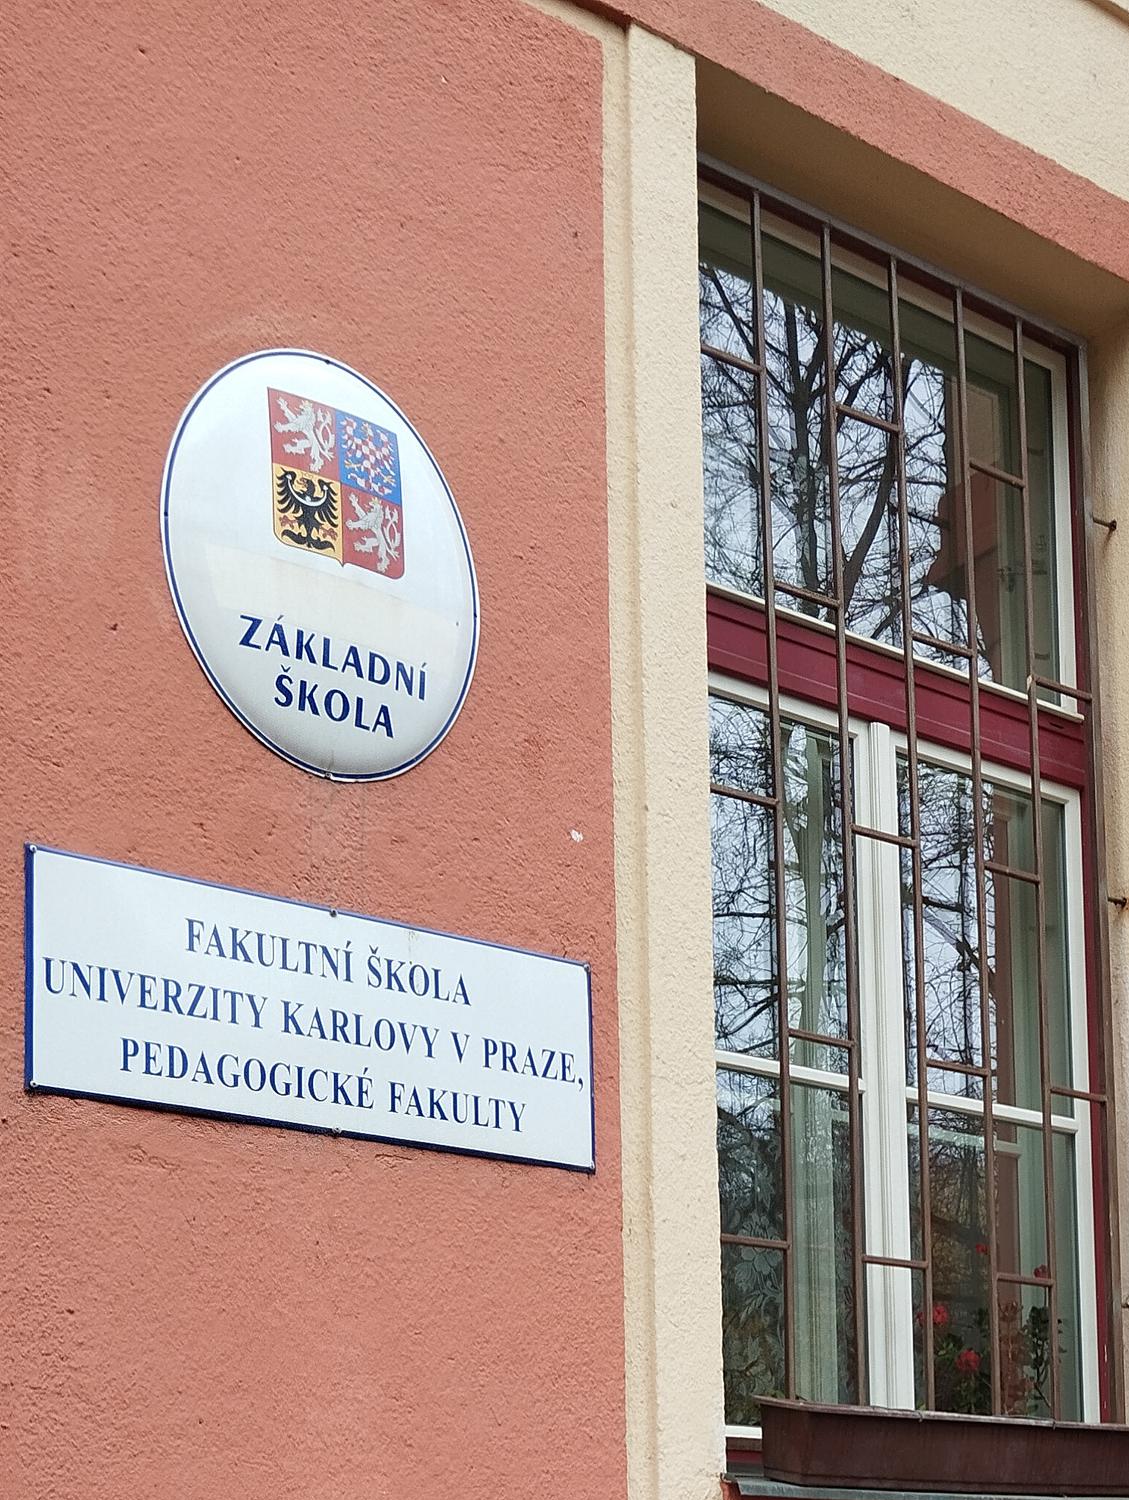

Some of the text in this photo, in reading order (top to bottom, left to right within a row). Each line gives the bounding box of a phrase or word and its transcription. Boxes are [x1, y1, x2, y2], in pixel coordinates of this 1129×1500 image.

[238, 614, 428, 701] ZÁKLADNÍ
[274, 664, 394, 739] ŠKOLA
[185, 917, 472, 1006] FAKULTNÍ ŠKOLA
[43, 956, 585, 1092] UNIVERZITY KARLOVY V PRAZE,
[119, 1037, 527, 1133] PEDAGOGICKÉ FAKULTY
